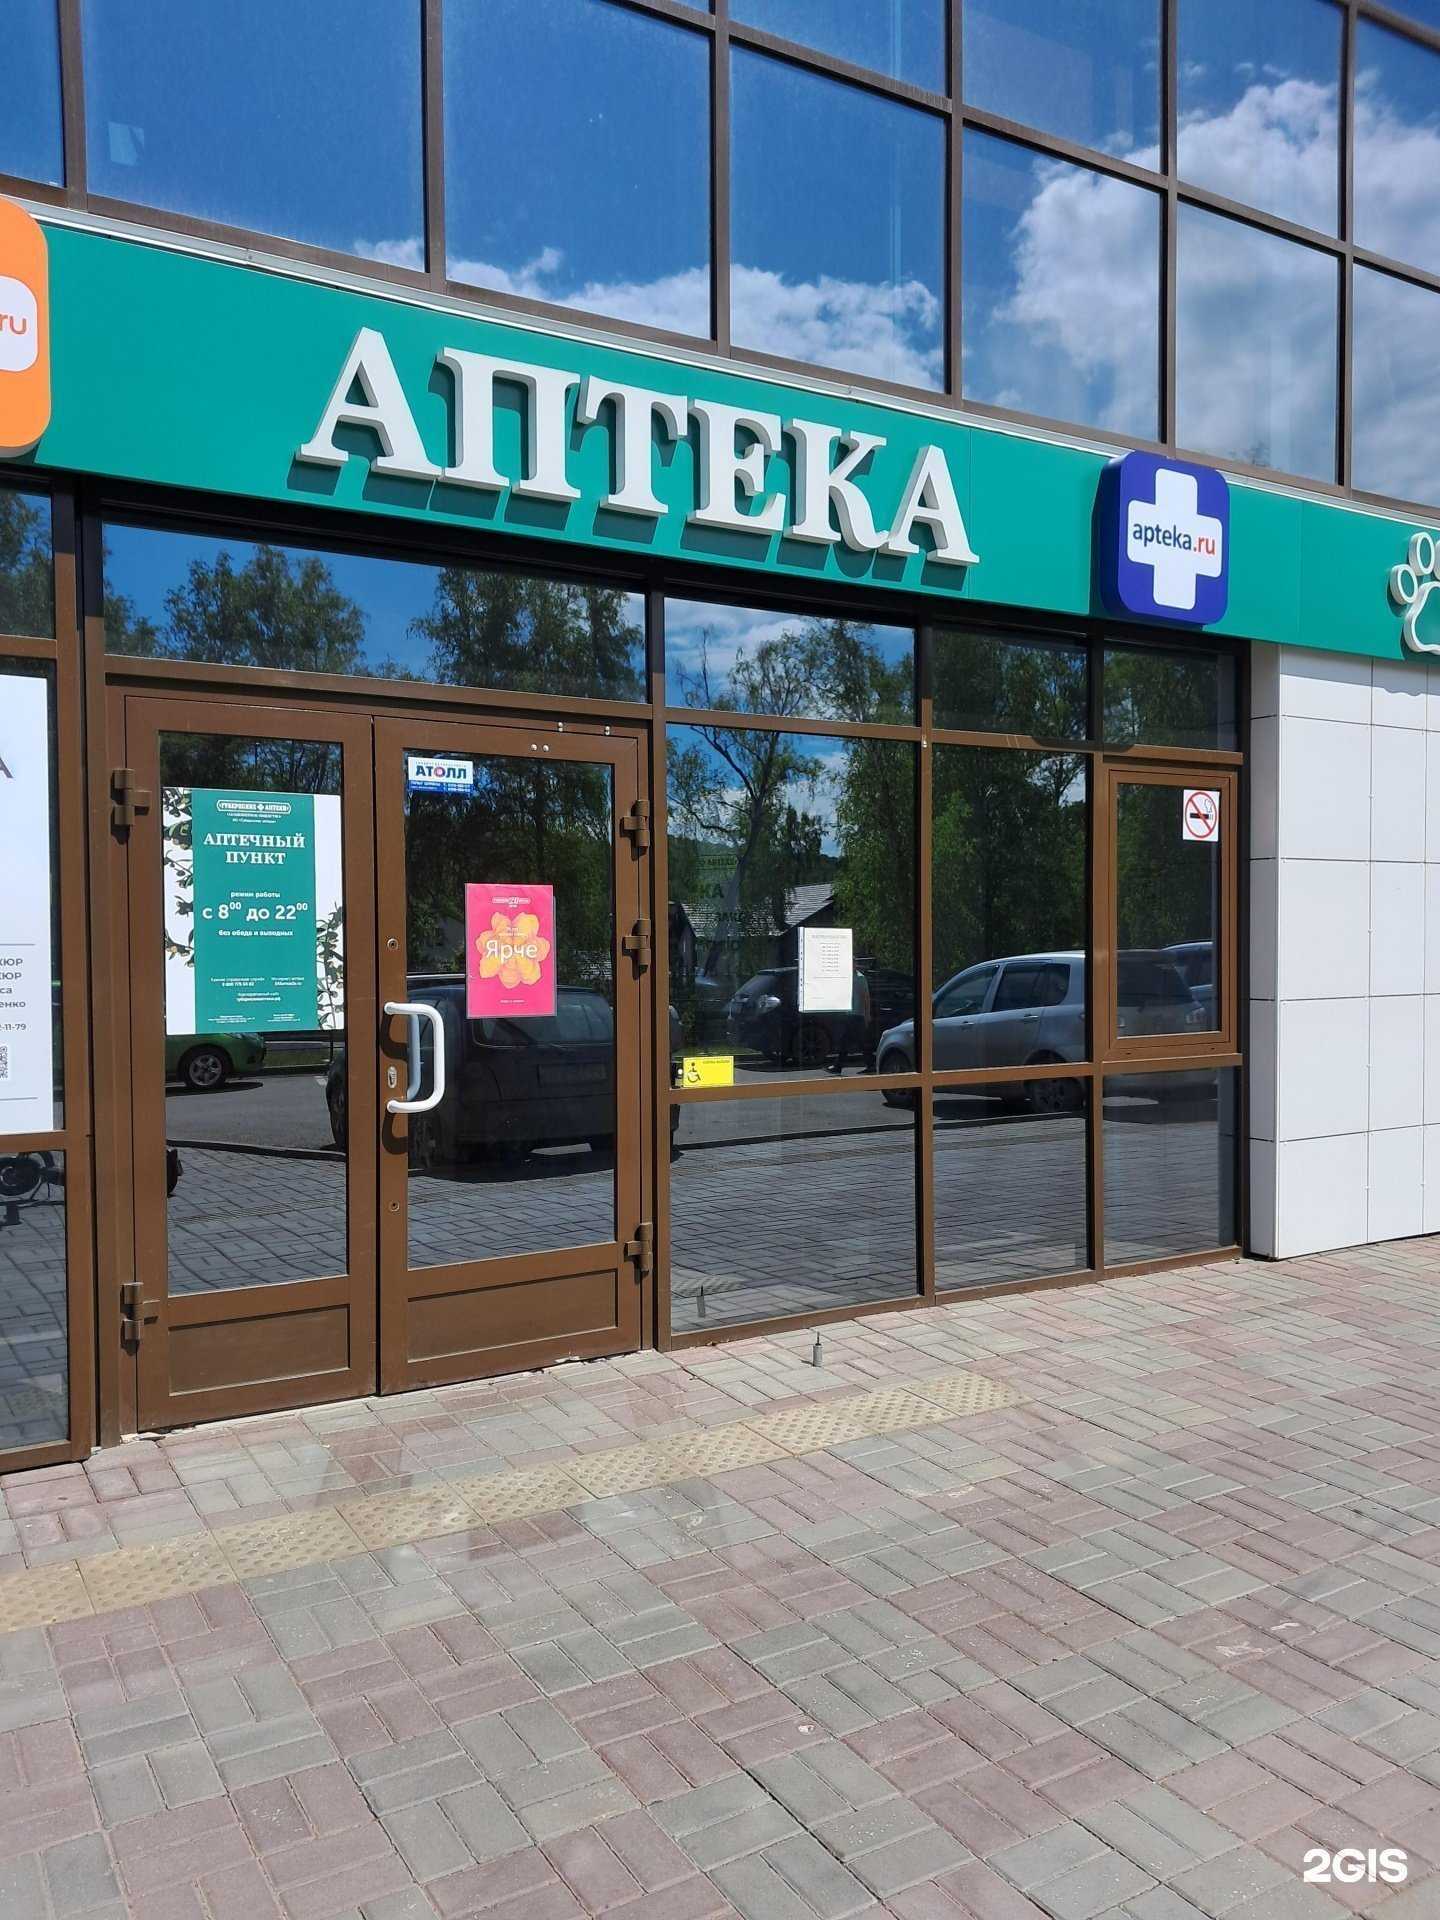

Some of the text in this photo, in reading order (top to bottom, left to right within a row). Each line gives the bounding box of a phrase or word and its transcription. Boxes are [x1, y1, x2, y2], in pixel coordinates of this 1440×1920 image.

[297, 326, 979, 565] АПТЕКА
[1132, 521, 1216, 555] apteka.ru
[416, 765, 467, 779] АТОЛЛ
[203, 833, 305, 848] АПТЕЧНЫЙ
[225, 851, 286, 864] ПУНКТ
[255, 891, 281, 899] работы
[246, 908, 270, 921] до
[486, 940, 538, 964] Ярче
[0, 1023, 27, 1031] -11-79
